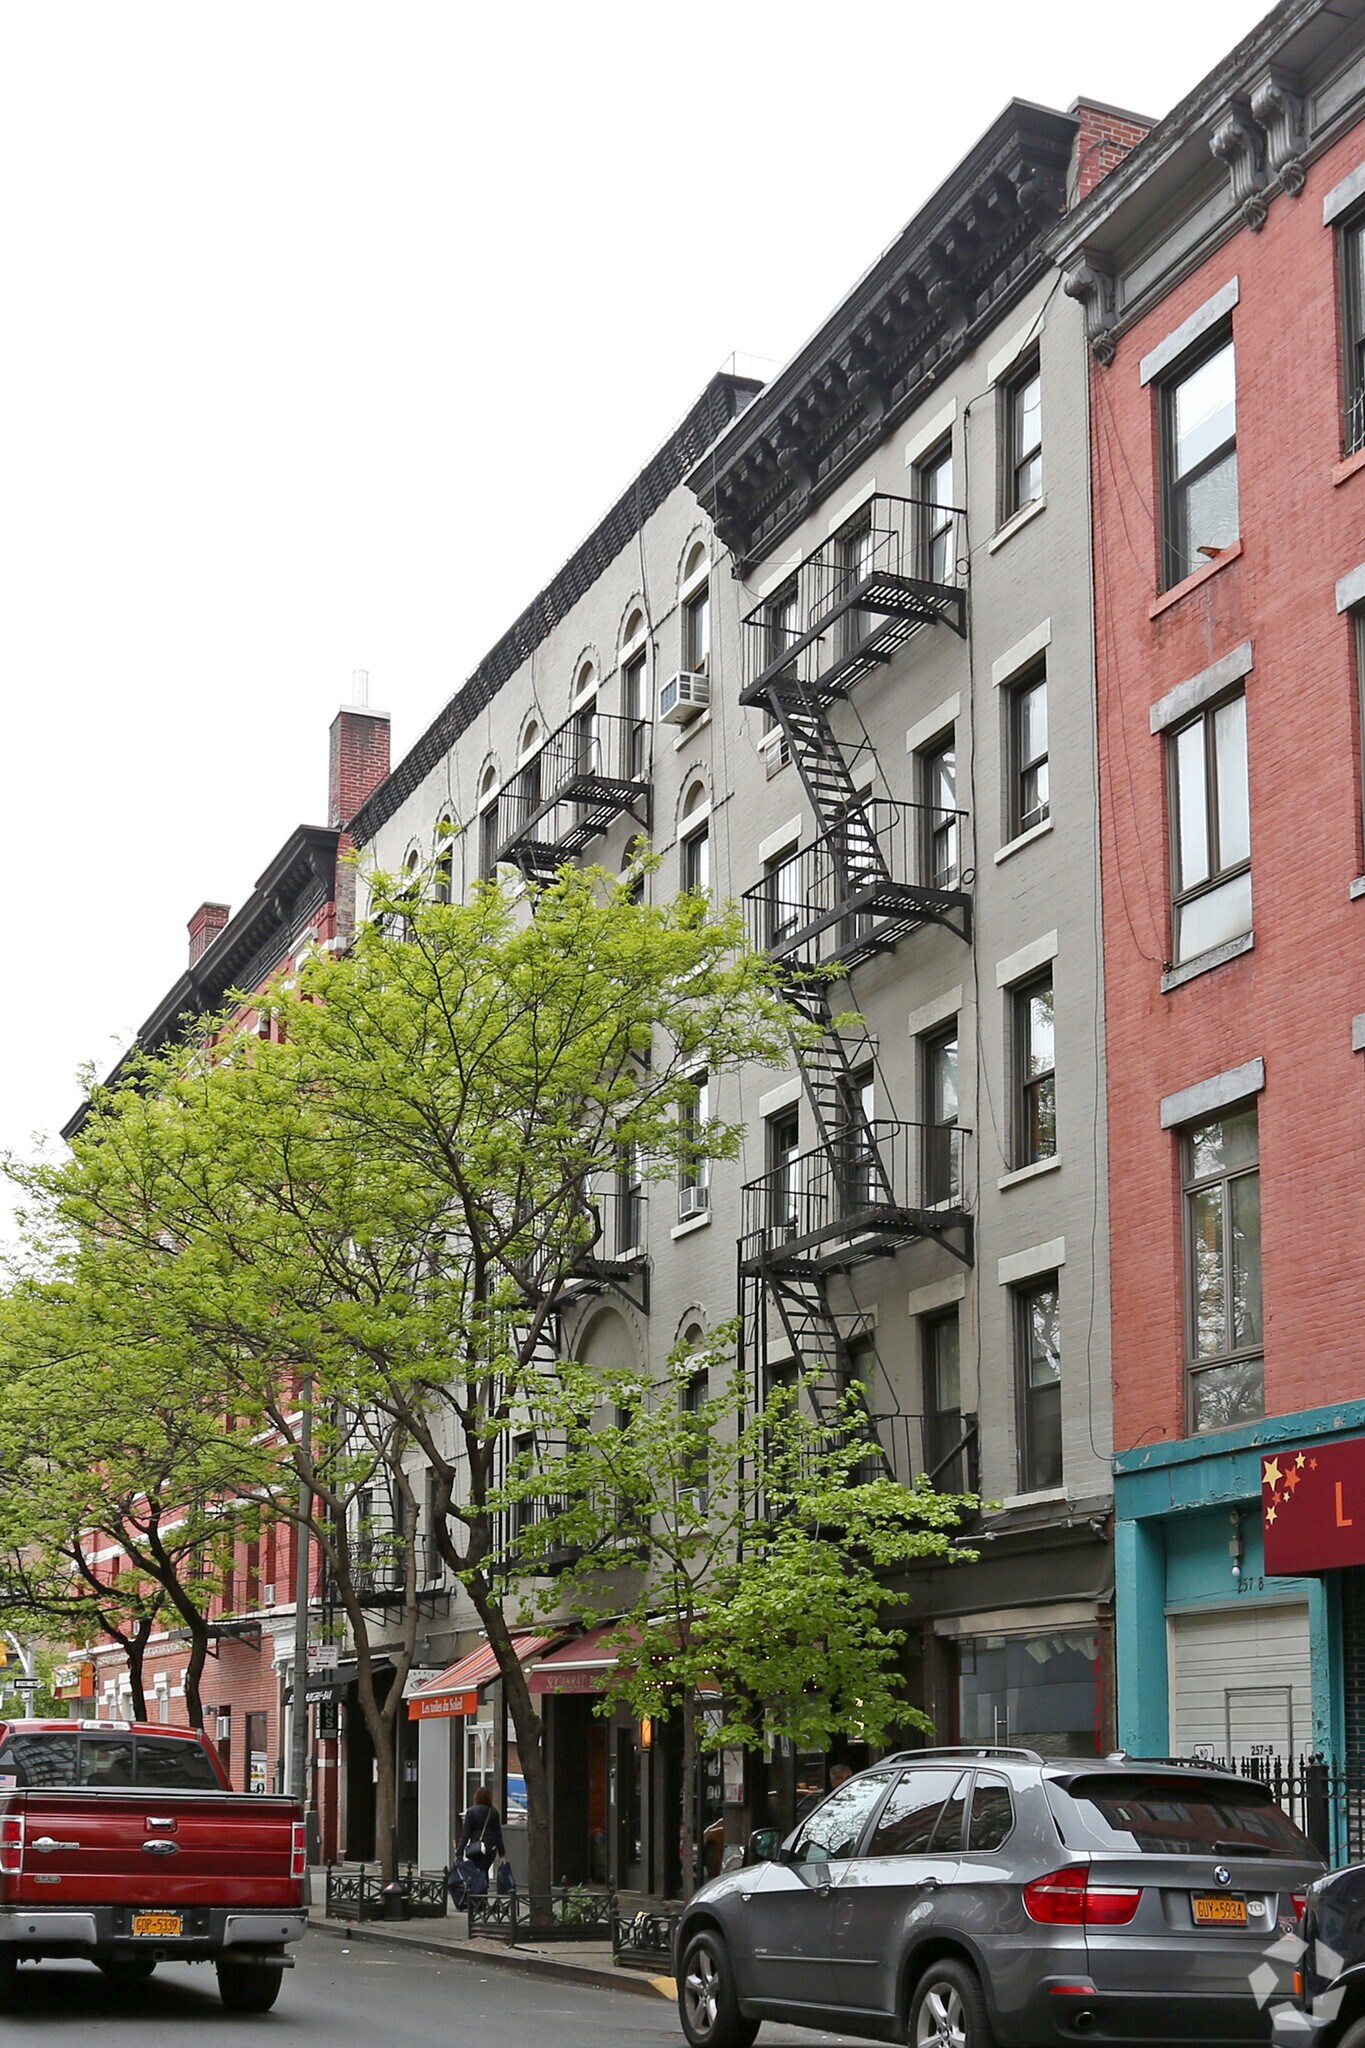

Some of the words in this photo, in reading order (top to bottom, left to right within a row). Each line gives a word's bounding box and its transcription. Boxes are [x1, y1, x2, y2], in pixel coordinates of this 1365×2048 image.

[1335, 1481, 1353, 1528] L
[1238, 1577, 1254, 1594] 257
[421, 1701, 430, 1714] Les
[450, 1696, 463, 1711] Soleil
[1250, 1745, 1274, 1756] 257-B
[1249, 1904, 1264, 1913] TCI
